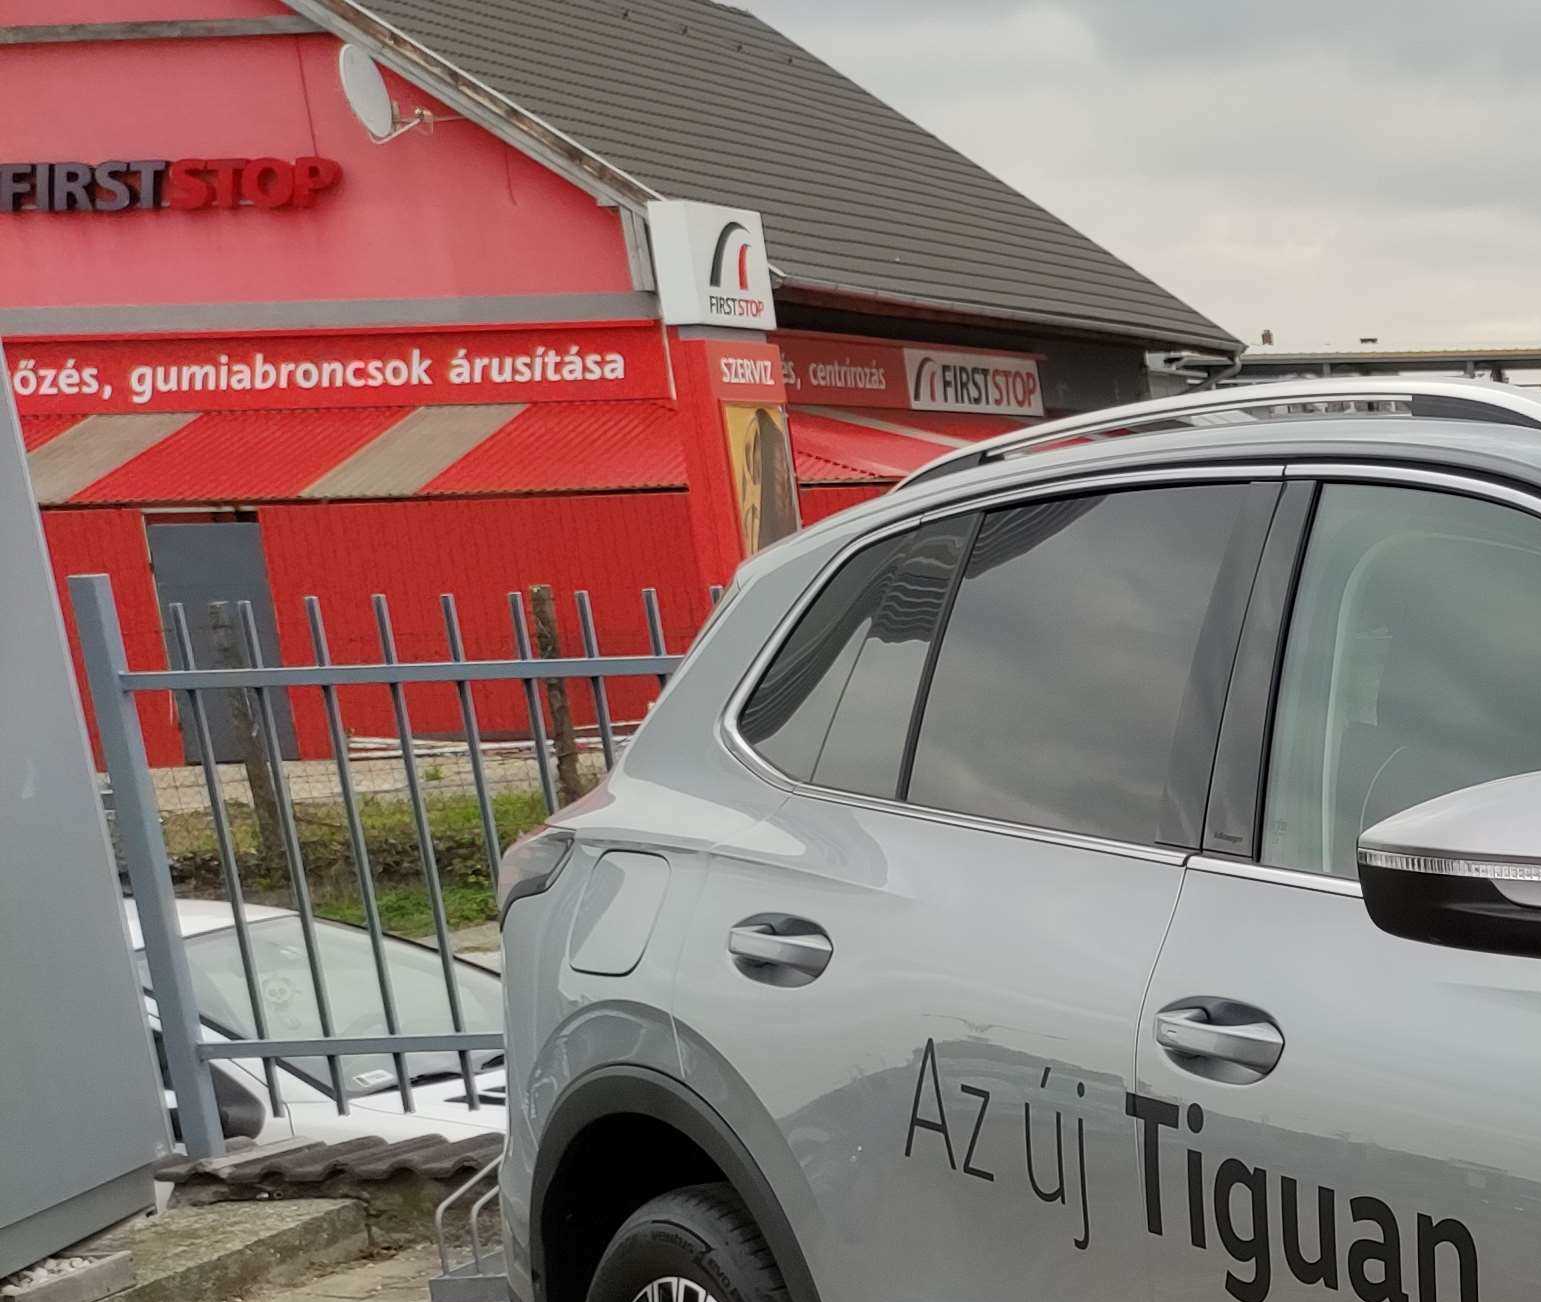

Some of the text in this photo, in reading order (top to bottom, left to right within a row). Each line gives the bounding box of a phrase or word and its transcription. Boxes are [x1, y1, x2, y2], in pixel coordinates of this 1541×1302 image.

[130, 349, 433, 404] gumiabroncsok
[449, 345, 625, 385] árusítása
[720, 356, 775, 385] SZERVIZ
[904, 1037, 995, 1182] Az
[1023, 1066, 1091, 1250] új
